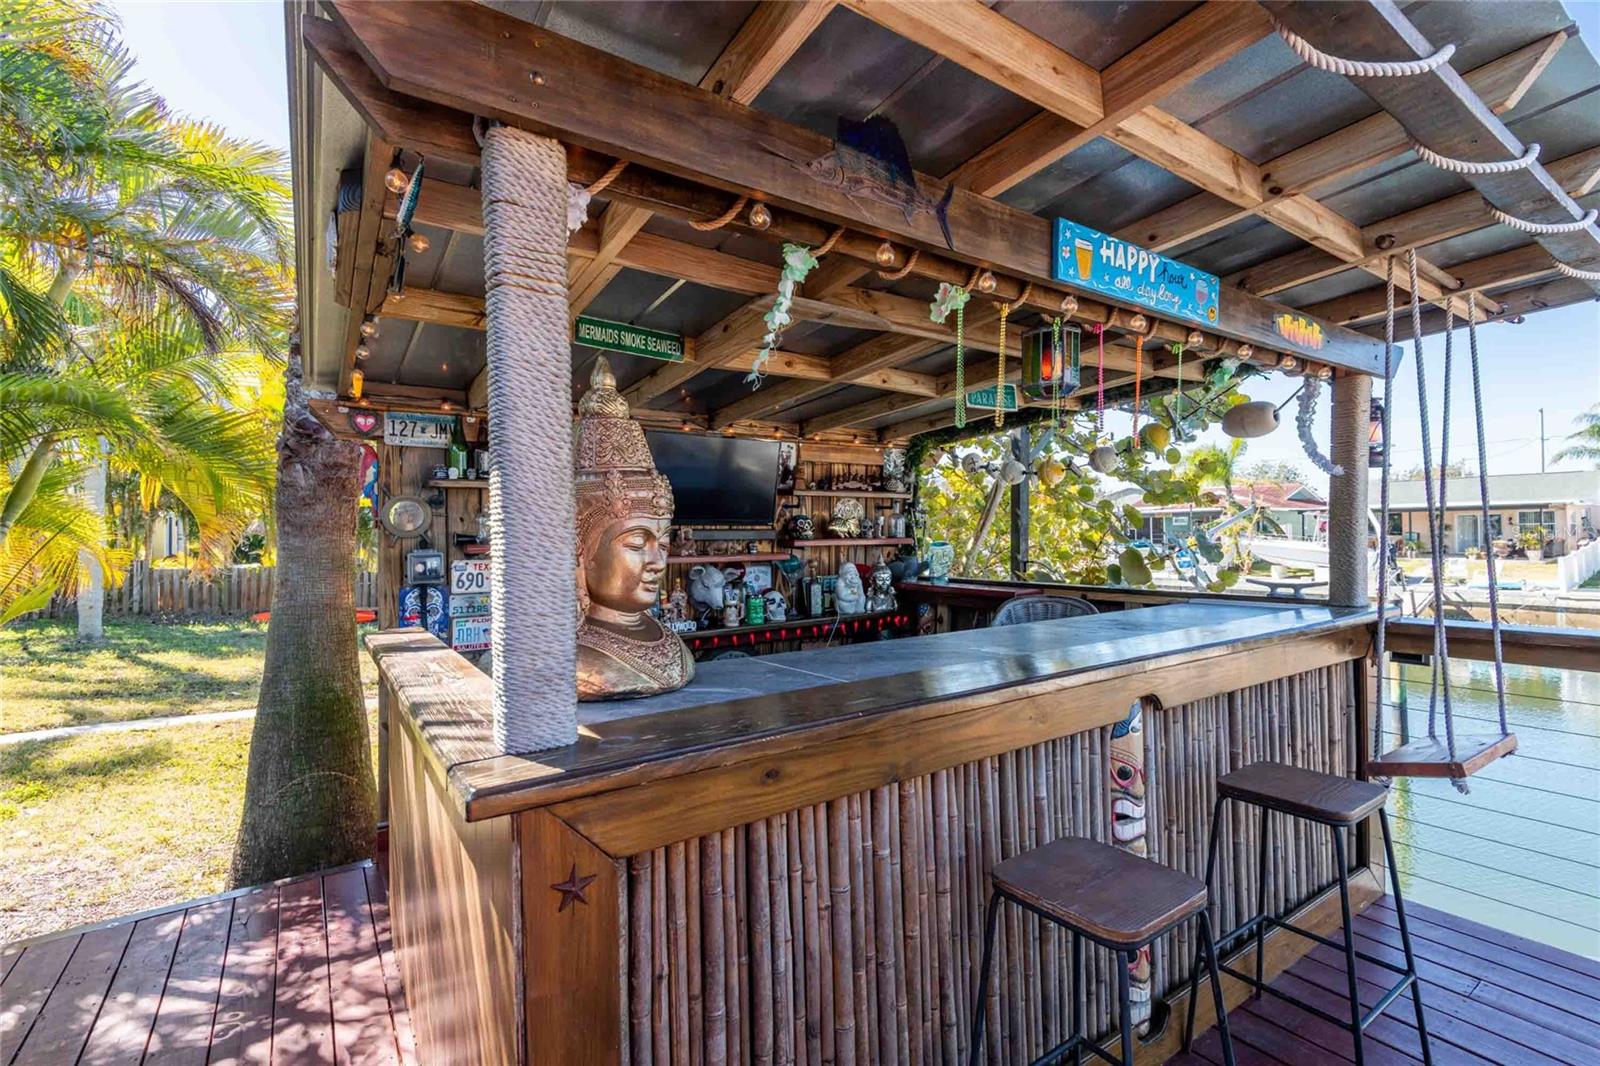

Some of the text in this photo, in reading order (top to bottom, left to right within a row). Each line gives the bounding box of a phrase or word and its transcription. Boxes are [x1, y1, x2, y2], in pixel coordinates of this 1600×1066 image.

[1100, 240, 1187, 289] HAPPY hour
[1115, 275, 1133, 291] all
[578, 323, 681, 355] MERMAIDS SMOKE SEAWEED
[970, 392, 1013, 408] PARASE
[389, 420, 418, 438] 127
[474, 563, 490, 571] TEX
[456, 572, 484, 591] 690
